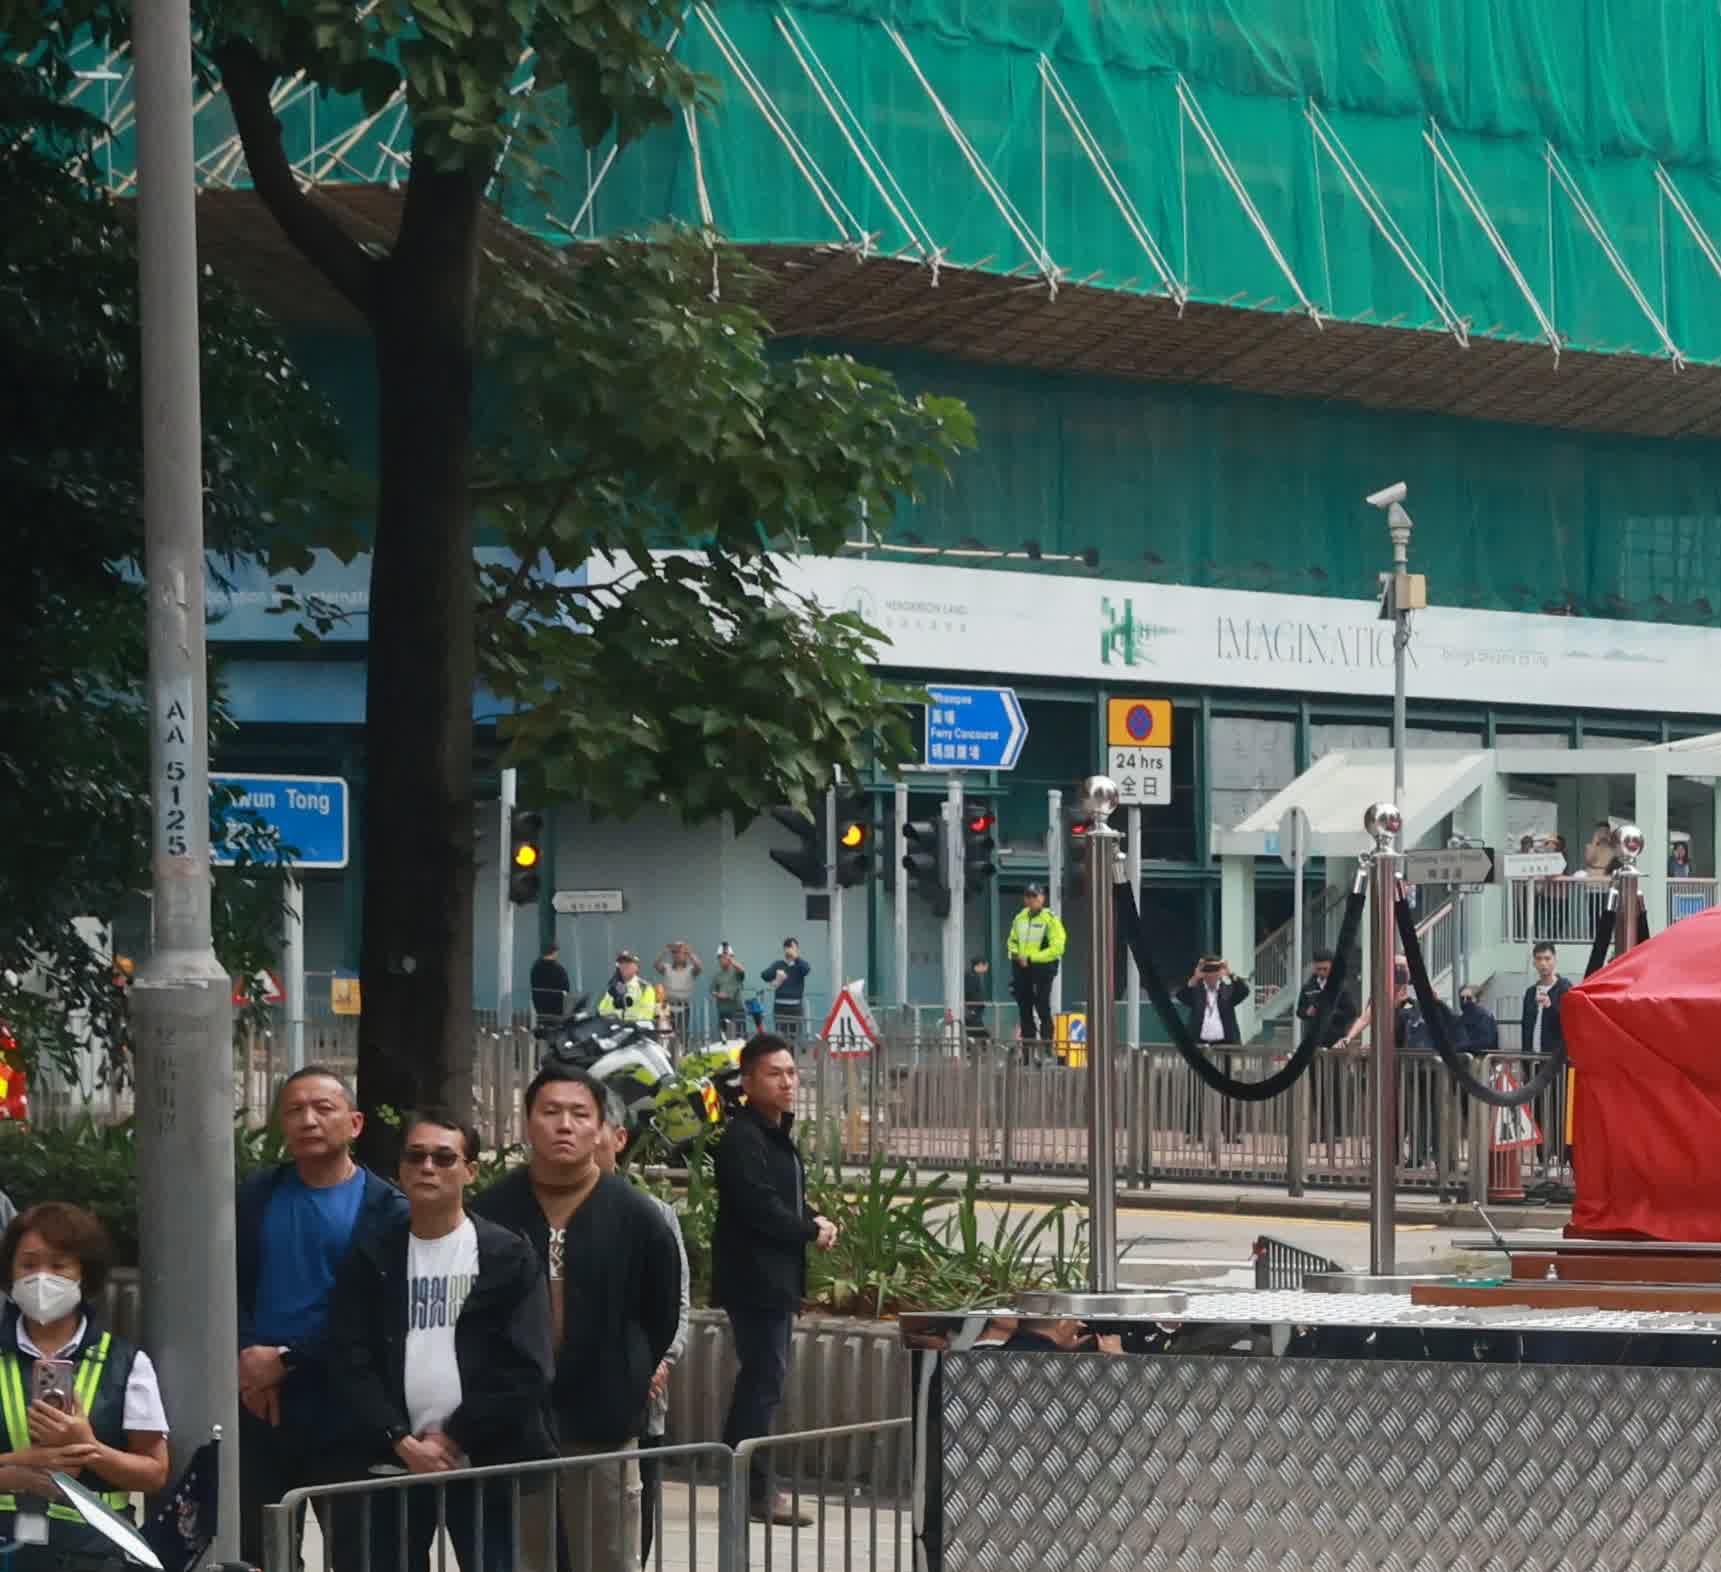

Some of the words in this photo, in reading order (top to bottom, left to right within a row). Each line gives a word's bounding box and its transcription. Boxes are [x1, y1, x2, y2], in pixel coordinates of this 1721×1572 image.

[166, 700, 186, 745] AA
[1116, 752, 1137, 769] 24
[1140, 754, 1163, 769] hrs
[1120, 775, 1158, 797] 全日
[165, 761, 187, 857] 5125
[285, 788, 331, 815] Tong
